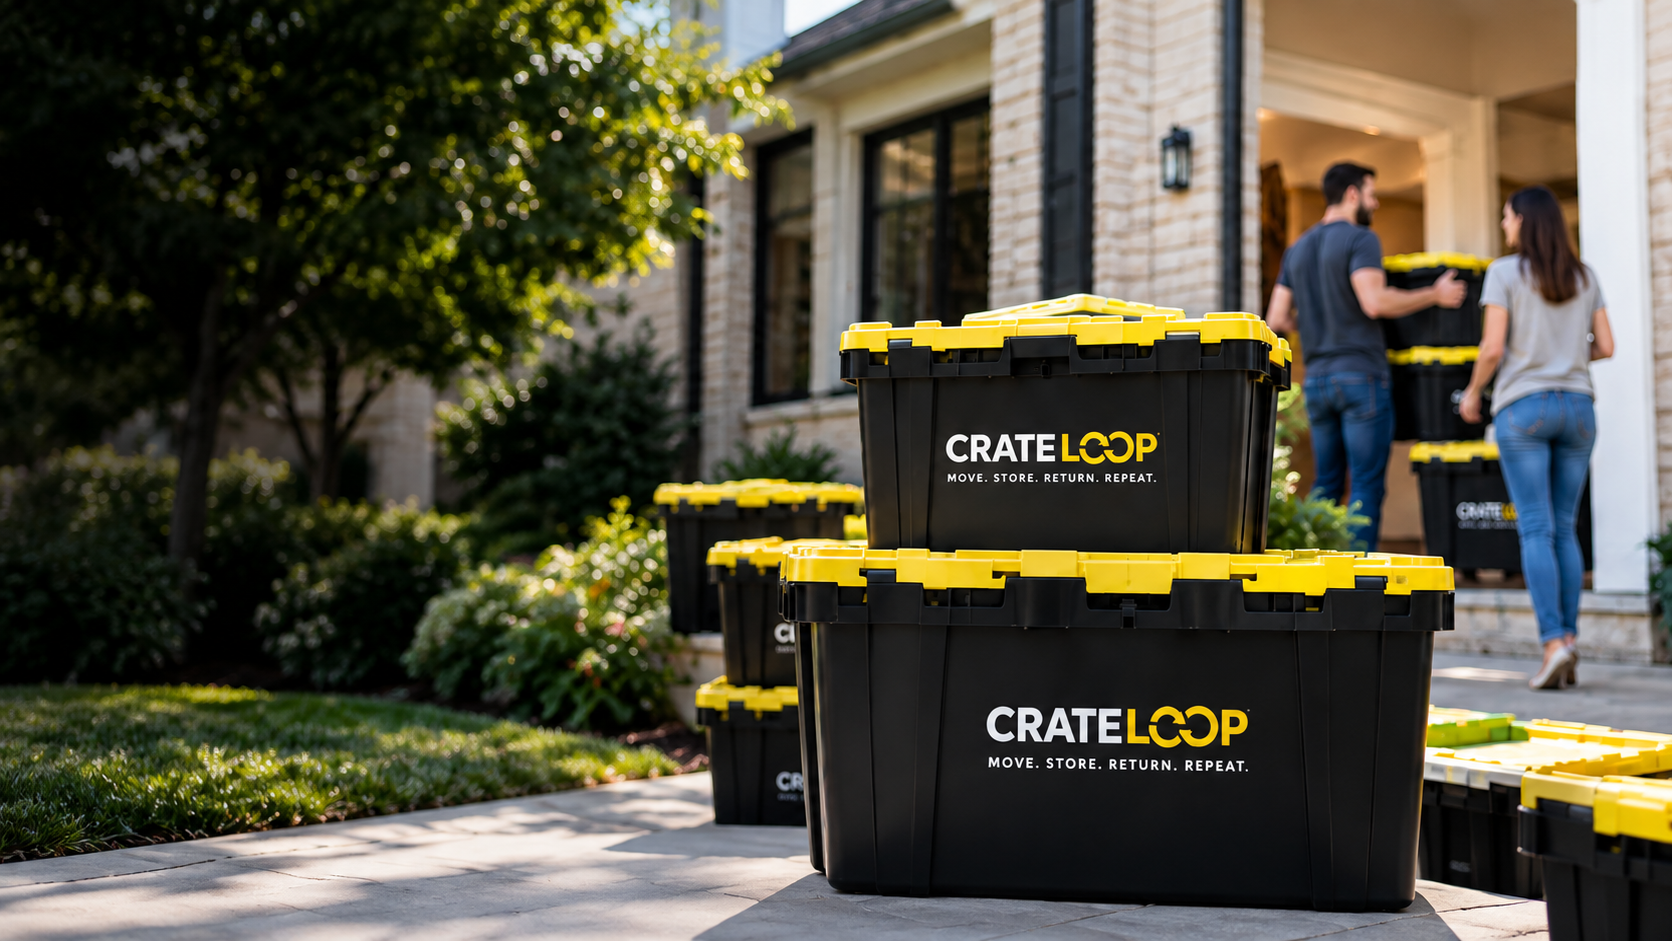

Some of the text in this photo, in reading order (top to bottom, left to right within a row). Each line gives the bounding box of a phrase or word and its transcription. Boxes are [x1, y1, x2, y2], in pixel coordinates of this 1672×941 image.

[946, 434, 1055, 463] CRATE
[948, 473, 1156, 482] MOVE. STORE. RETURN. REPEAT.
[988, 757, 1248, 772] MOVE. STORE. RETURN. REPEAT.
